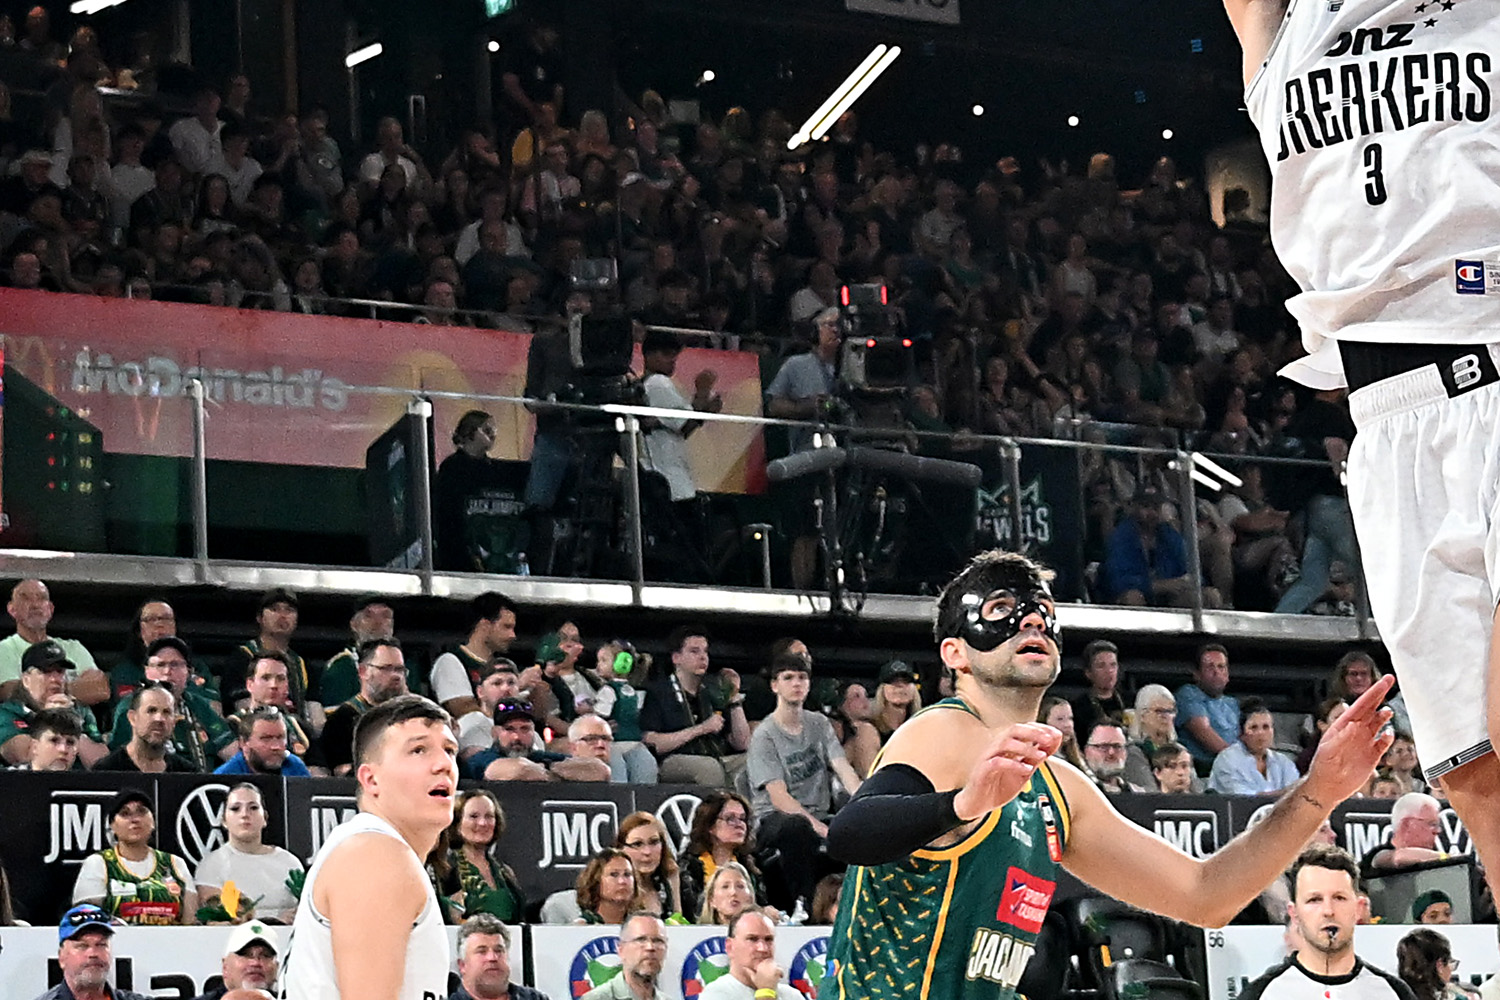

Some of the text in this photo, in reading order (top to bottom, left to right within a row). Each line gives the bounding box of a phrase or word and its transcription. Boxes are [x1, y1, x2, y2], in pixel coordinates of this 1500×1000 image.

[1277, 52, 1491, 161] REAKERS
[1364, 143, 1388, 206] 3
[44, 804, 116, 863] JM
[539, 812, 611, 868] JMC
[1209, 931, 1225, 948] 56
